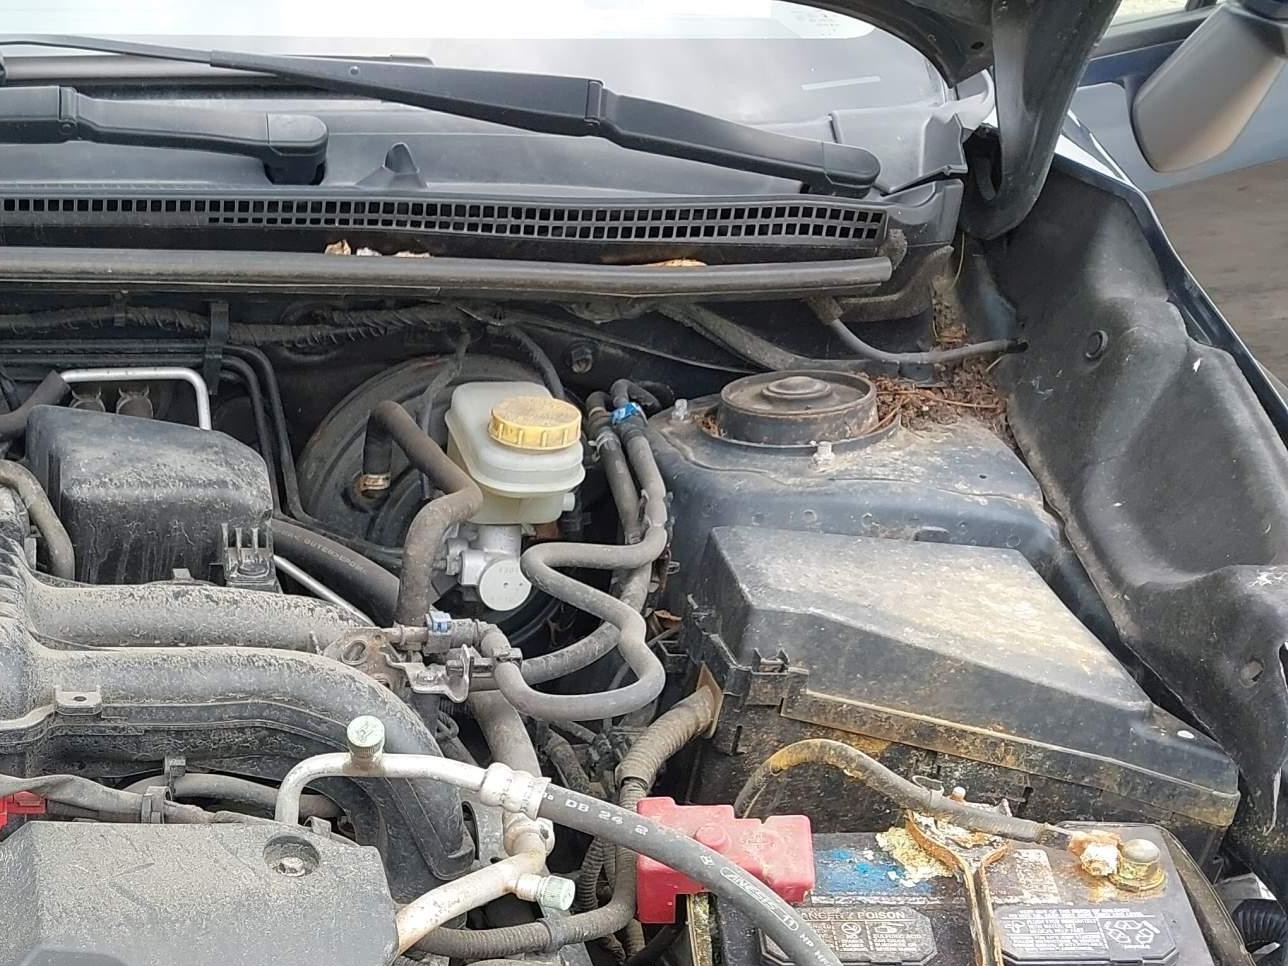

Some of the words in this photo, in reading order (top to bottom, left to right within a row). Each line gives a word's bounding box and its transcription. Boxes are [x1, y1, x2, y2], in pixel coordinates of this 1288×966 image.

[565, 799, 590, 813] DB
[598, 811, 624, 826] 24
[857, 911, 905, 920] POISON
